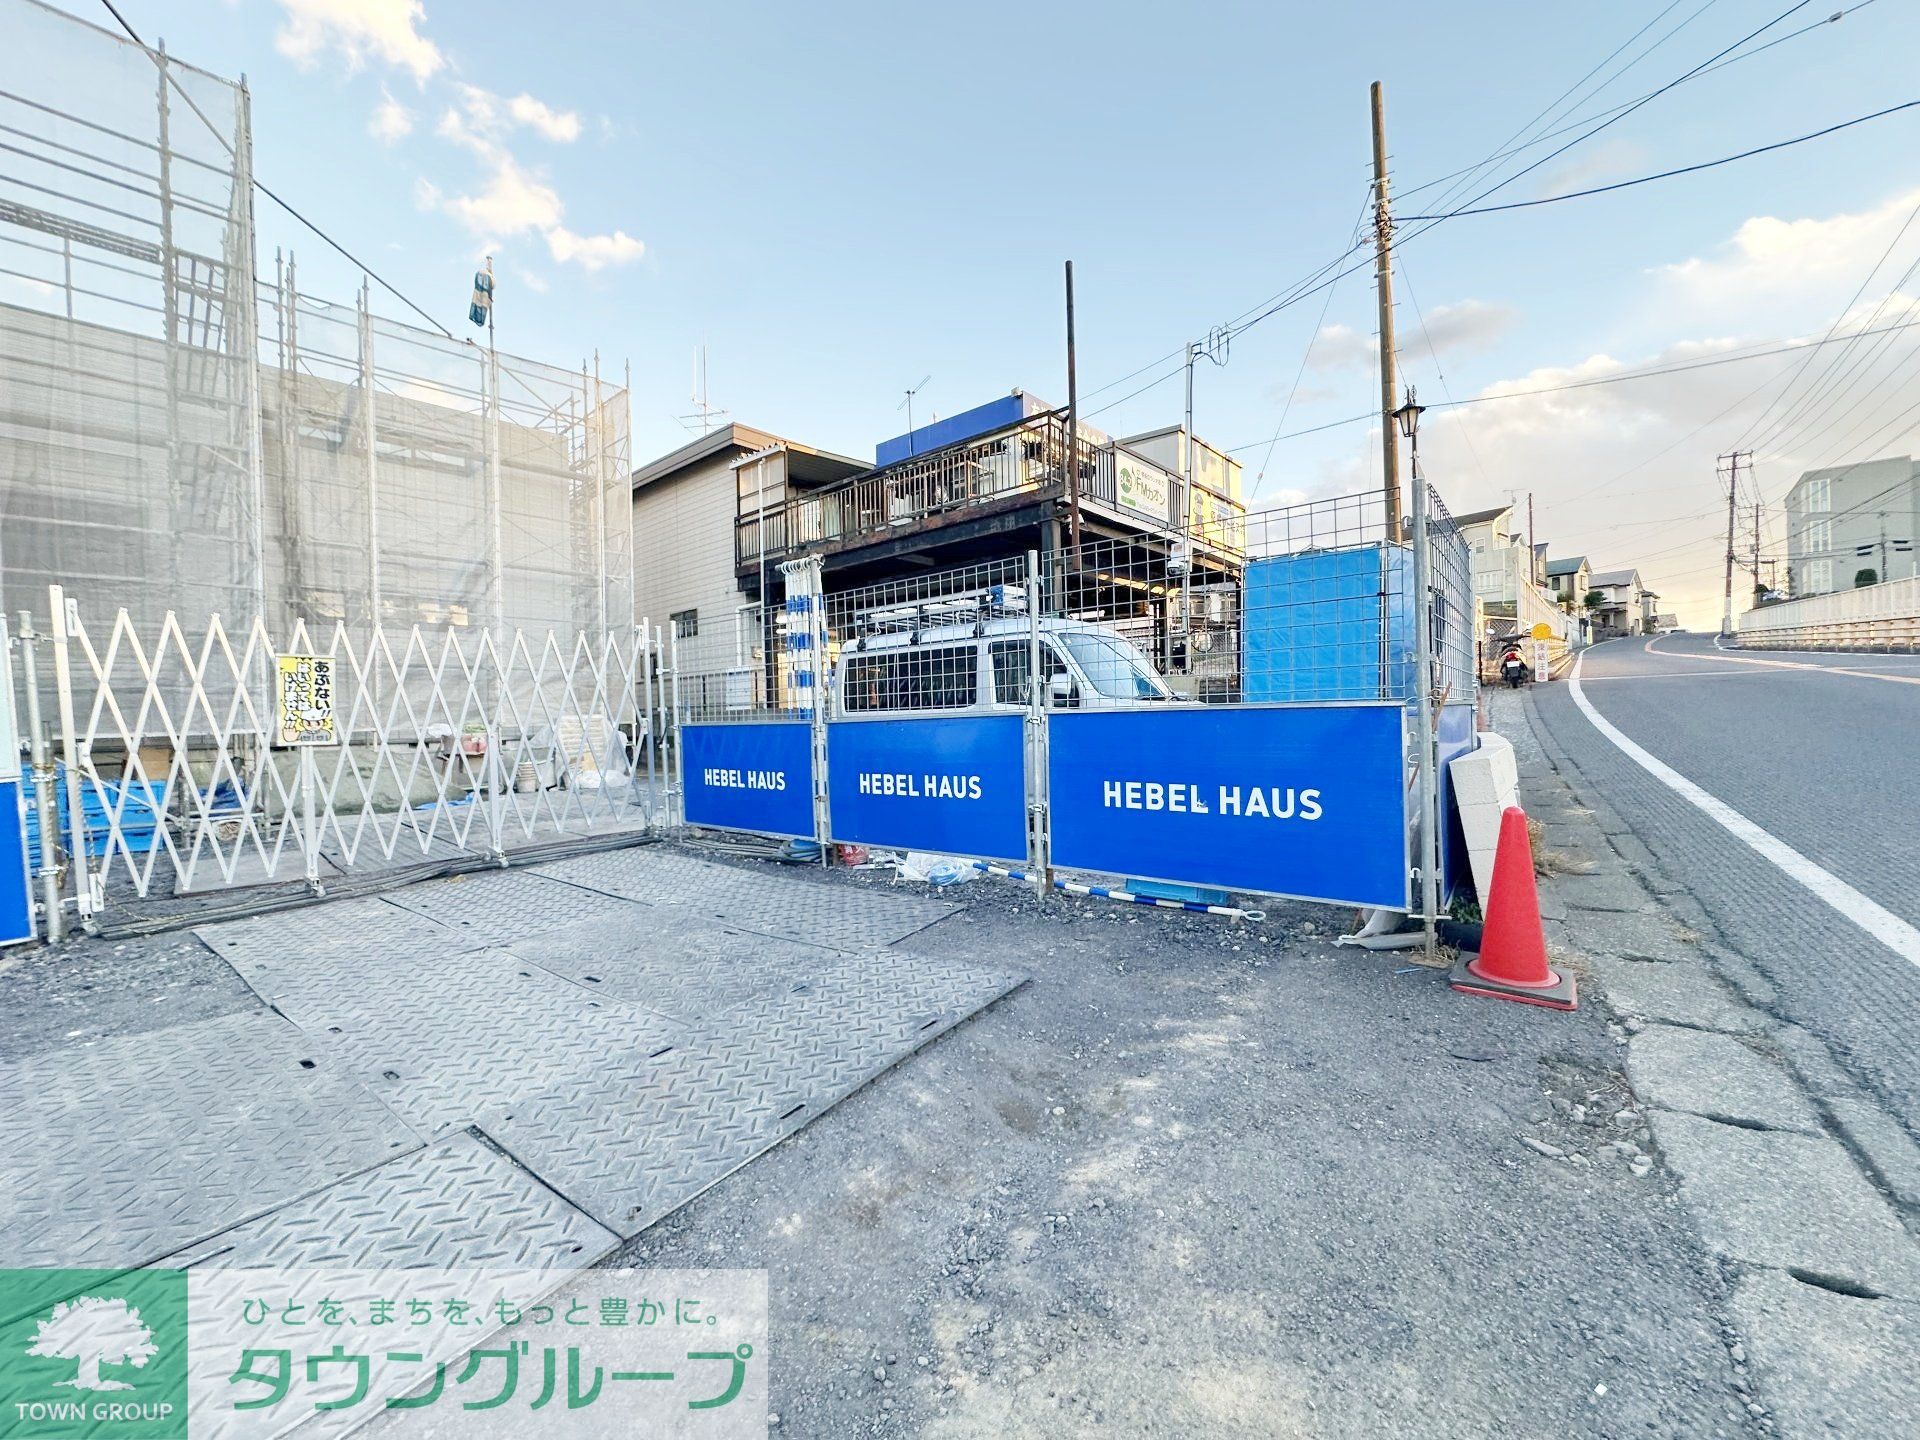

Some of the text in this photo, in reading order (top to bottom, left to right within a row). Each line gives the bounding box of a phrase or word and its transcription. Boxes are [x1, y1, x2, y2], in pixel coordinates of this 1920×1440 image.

[297, 662, 311, 711] はいっては
[704, 768, 786, 791] HEBEL HAUS
[859, 773, 982, 800] HEBEL HAUS
[1103, 780, 1323, 821] HEBEL HAUS
